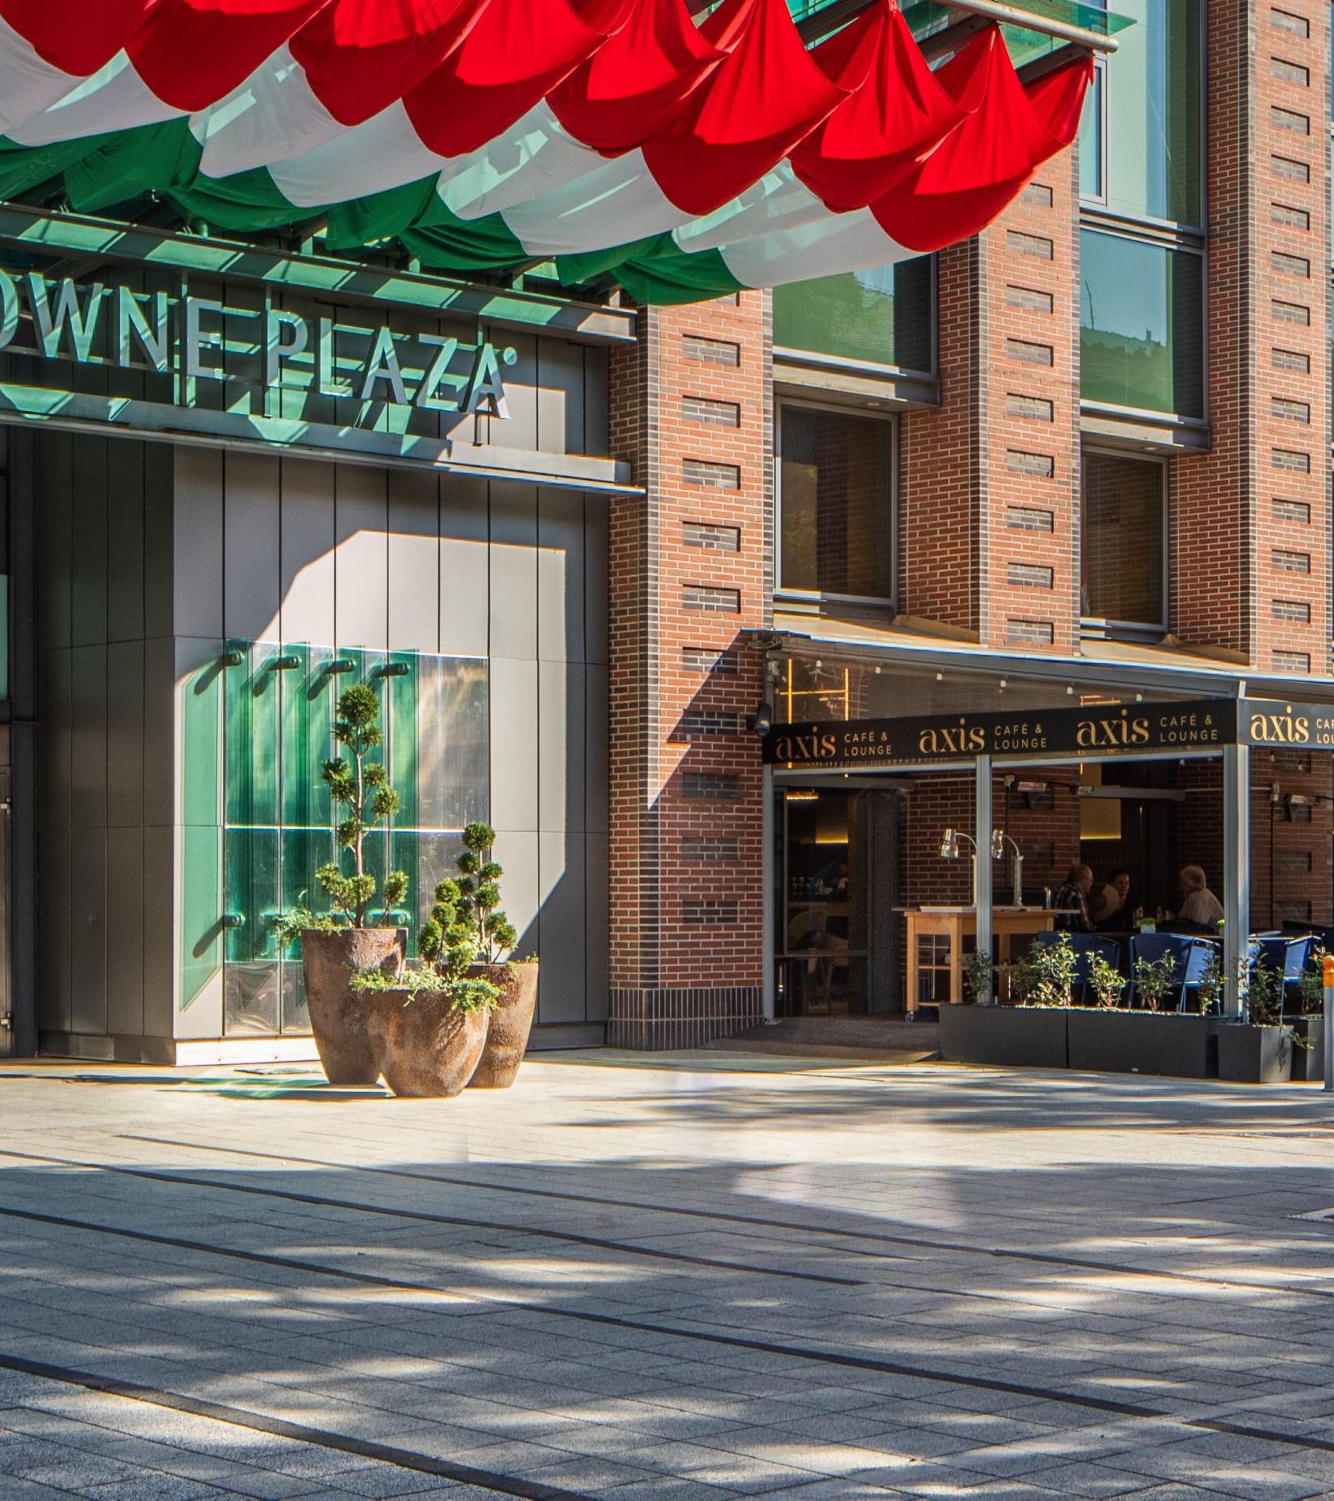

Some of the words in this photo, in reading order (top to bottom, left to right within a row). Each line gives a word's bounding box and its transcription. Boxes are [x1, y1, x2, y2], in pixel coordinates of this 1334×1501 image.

[266, 308, 512, 420] PLAZA
[1160, 713, 1197, 727] CAFÉ
[1205, 714, 1213, 725] &
[1250, 706, 1309, 743] axis
[994, 723, 1029, 737] CAFÉ
[1034, 723, 1042, 735] &
[1076, 709, 1149, 746] axis
[776, 726, 836, 759] axis
[844, 731, 875, 742] CAFÉ
[881, 732, 888, 741] &
[919, 718, 985, 754] axis
[1160, 729, 1218, 742] LOUNGE
[844, 745, 892, 756] LOUNGE
[994, 738, 1048, 750] LOUNGE
